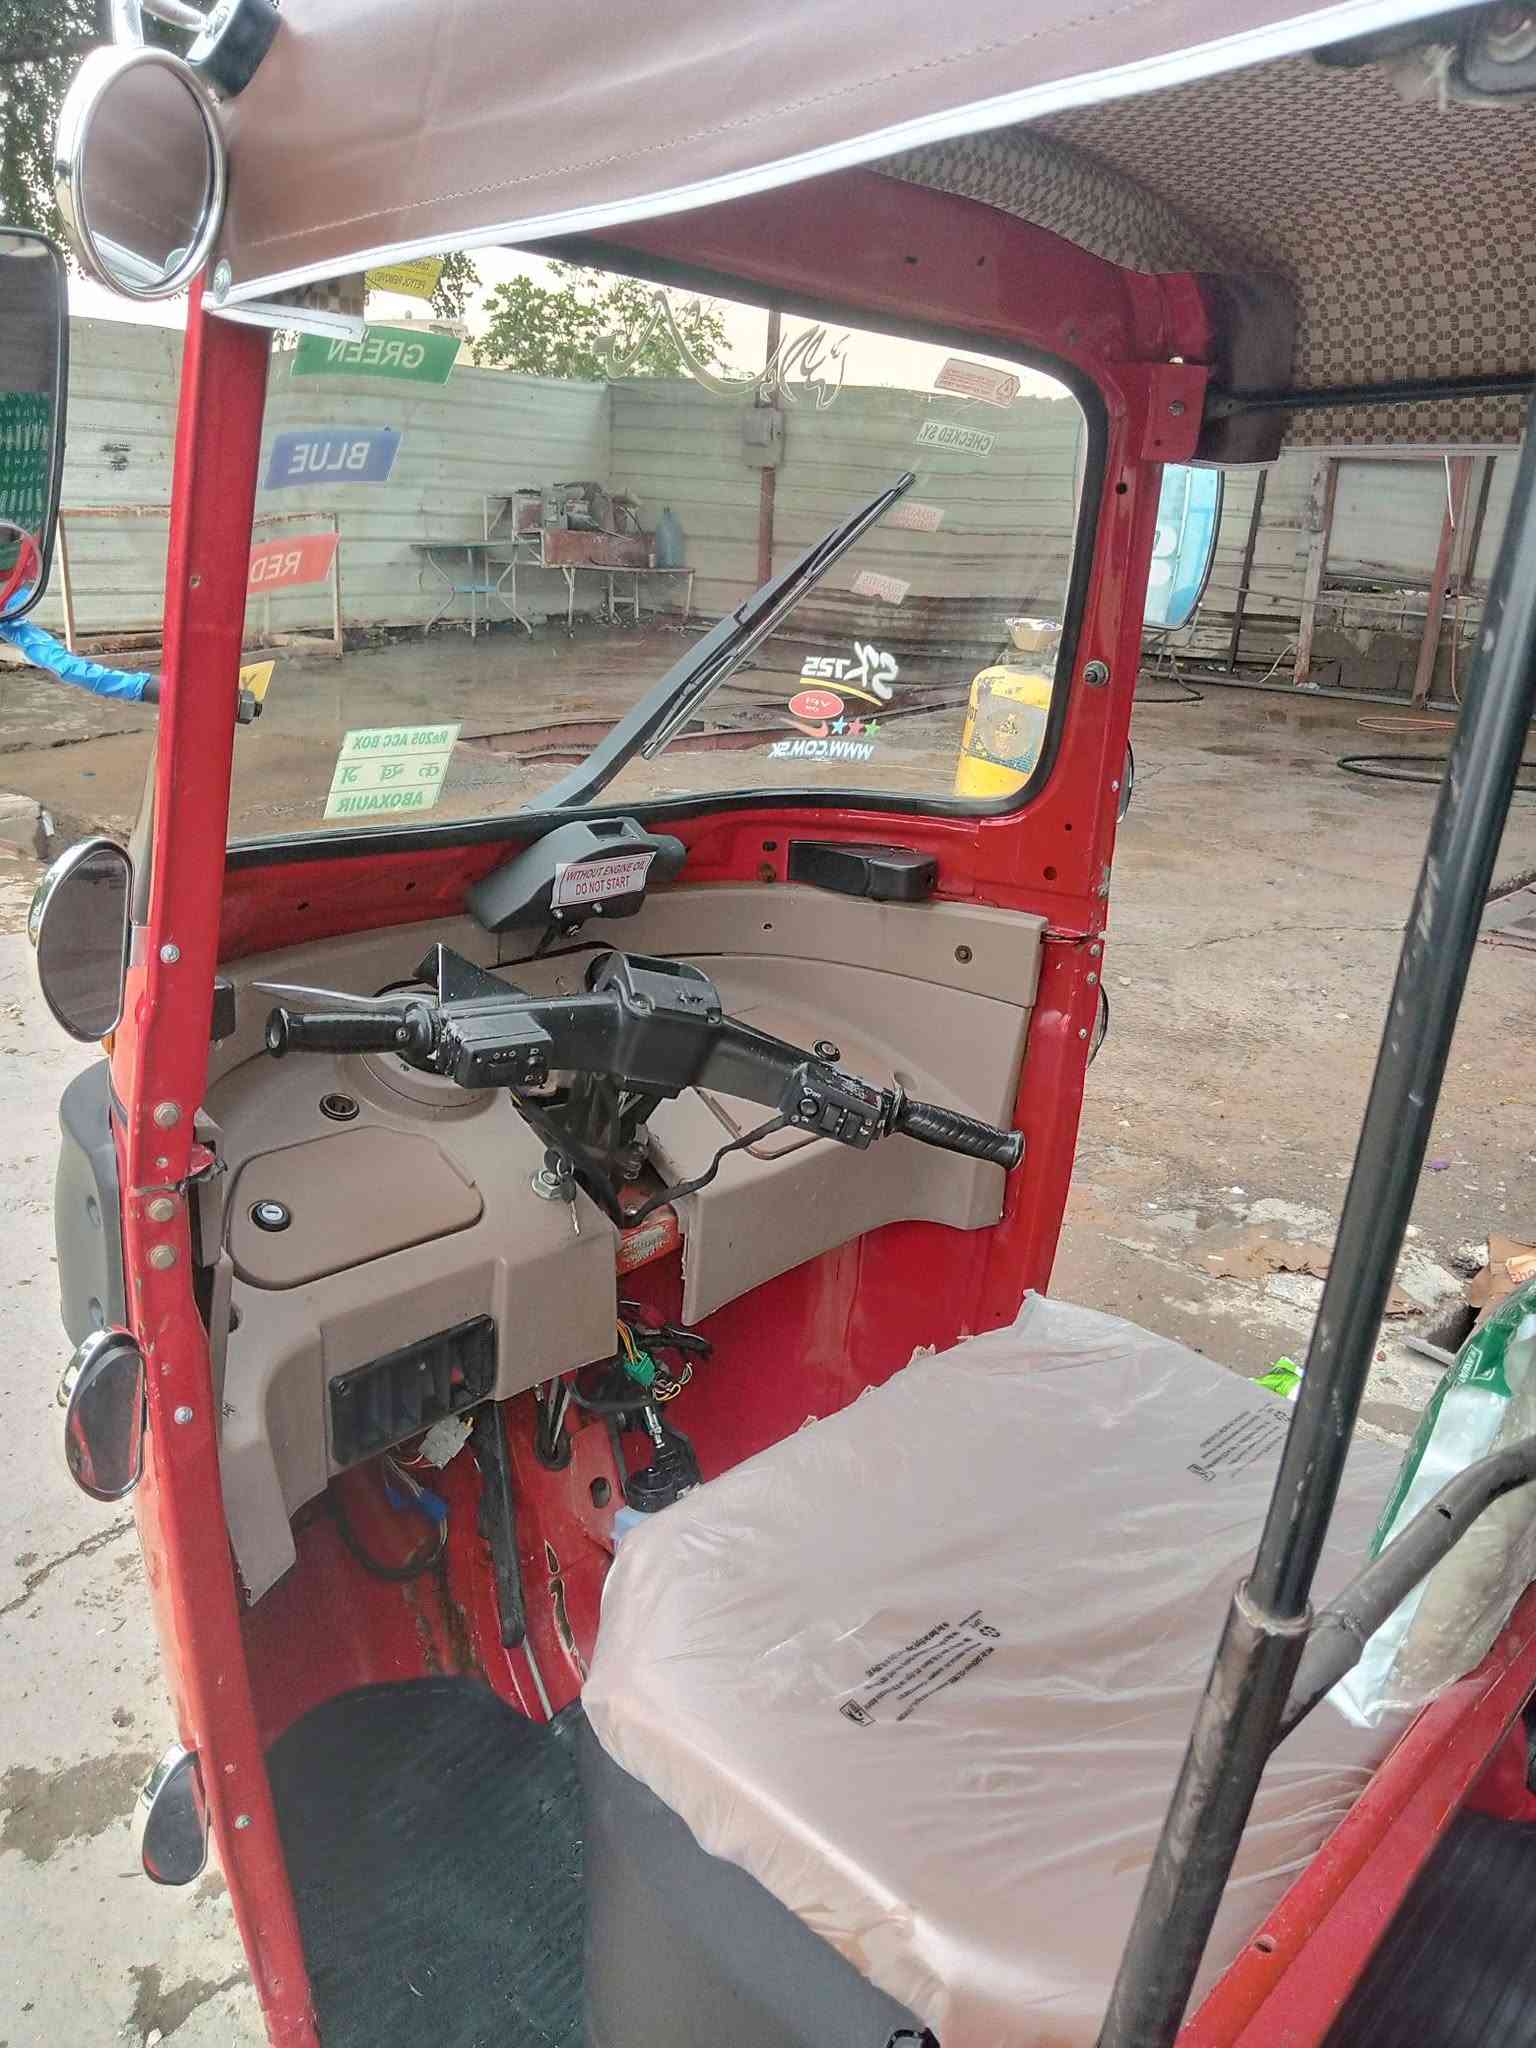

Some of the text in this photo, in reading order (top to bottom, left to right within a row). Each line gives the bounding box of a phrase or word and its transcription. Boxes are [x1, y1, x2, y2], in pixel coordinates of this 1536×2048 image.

[566, 868, 604, 881] WITHOUT
[605, 862, 633, 876] ENGINE
[576, 876, 630, 896] DO NOT START
